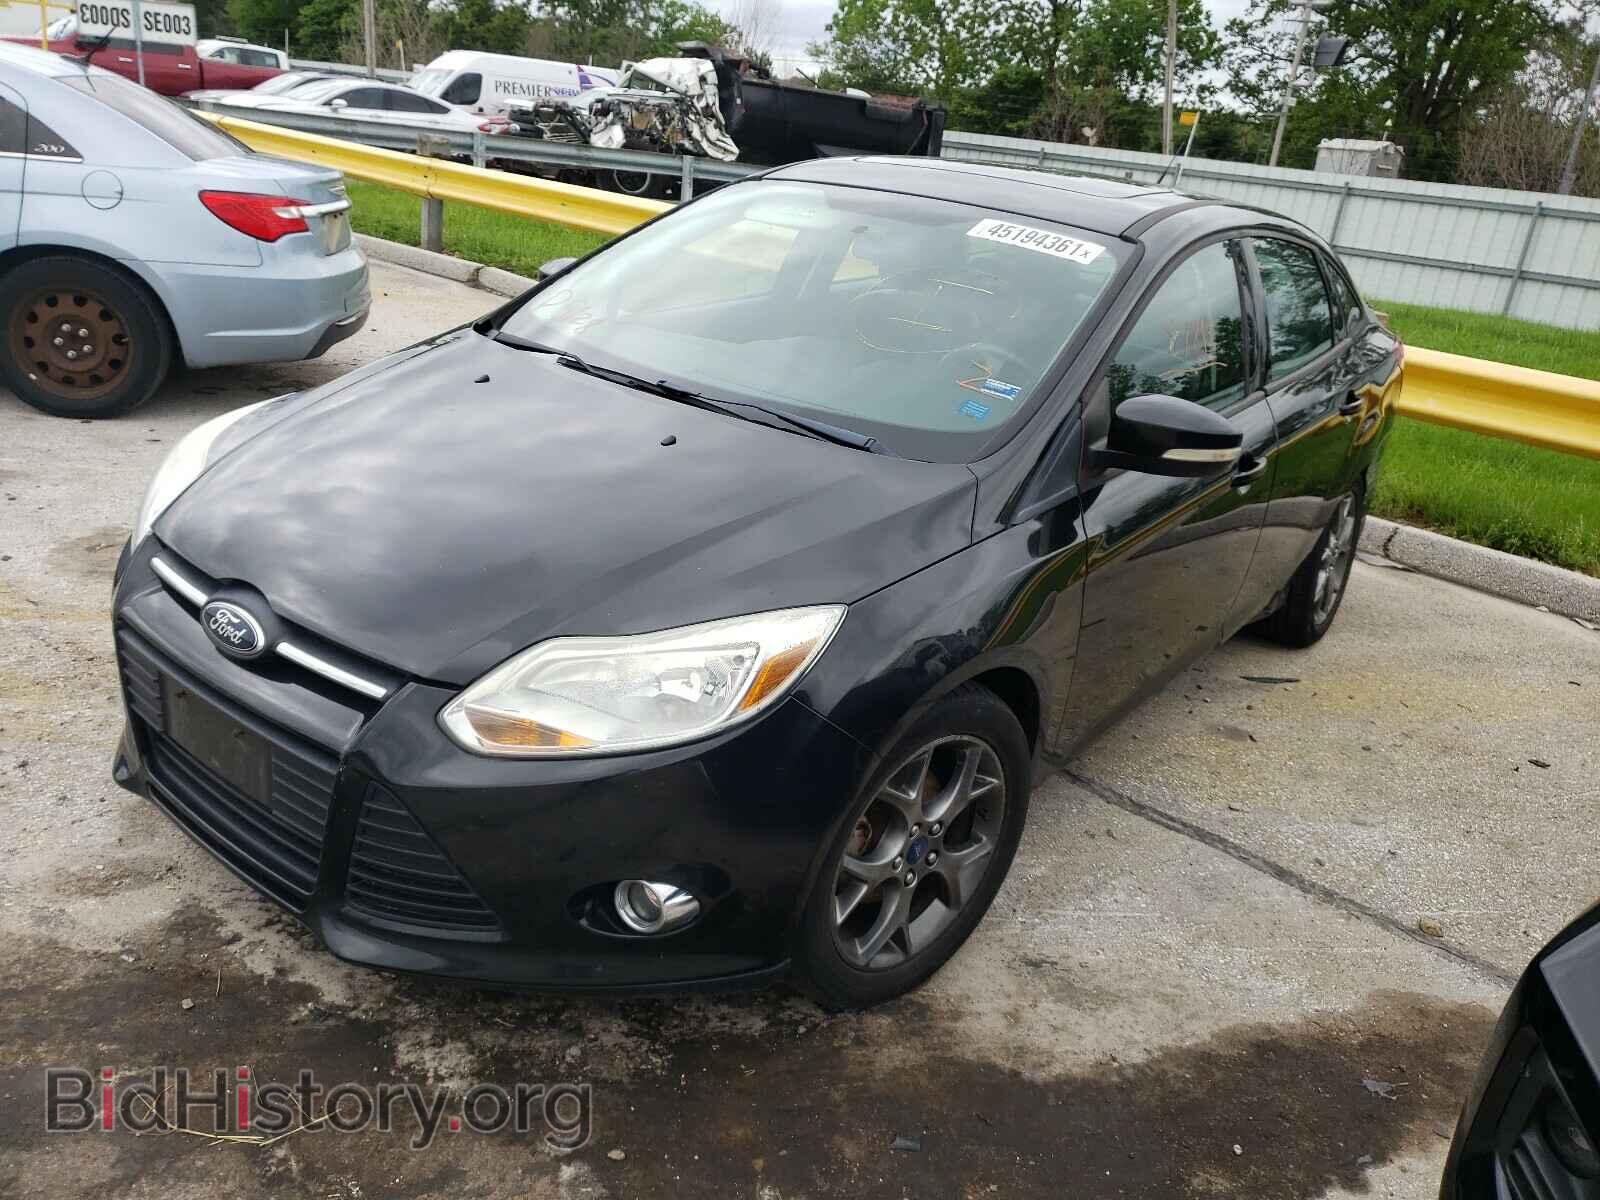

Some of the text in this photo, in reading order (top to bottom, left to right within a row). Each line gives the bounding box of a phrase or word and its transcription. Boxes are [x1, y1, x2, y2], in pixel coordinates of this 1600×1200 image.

[143, 11, 191, 35] SE003
[494, 80, 552, 97] PREMIER
[210, 609, 247, 644] Ford
